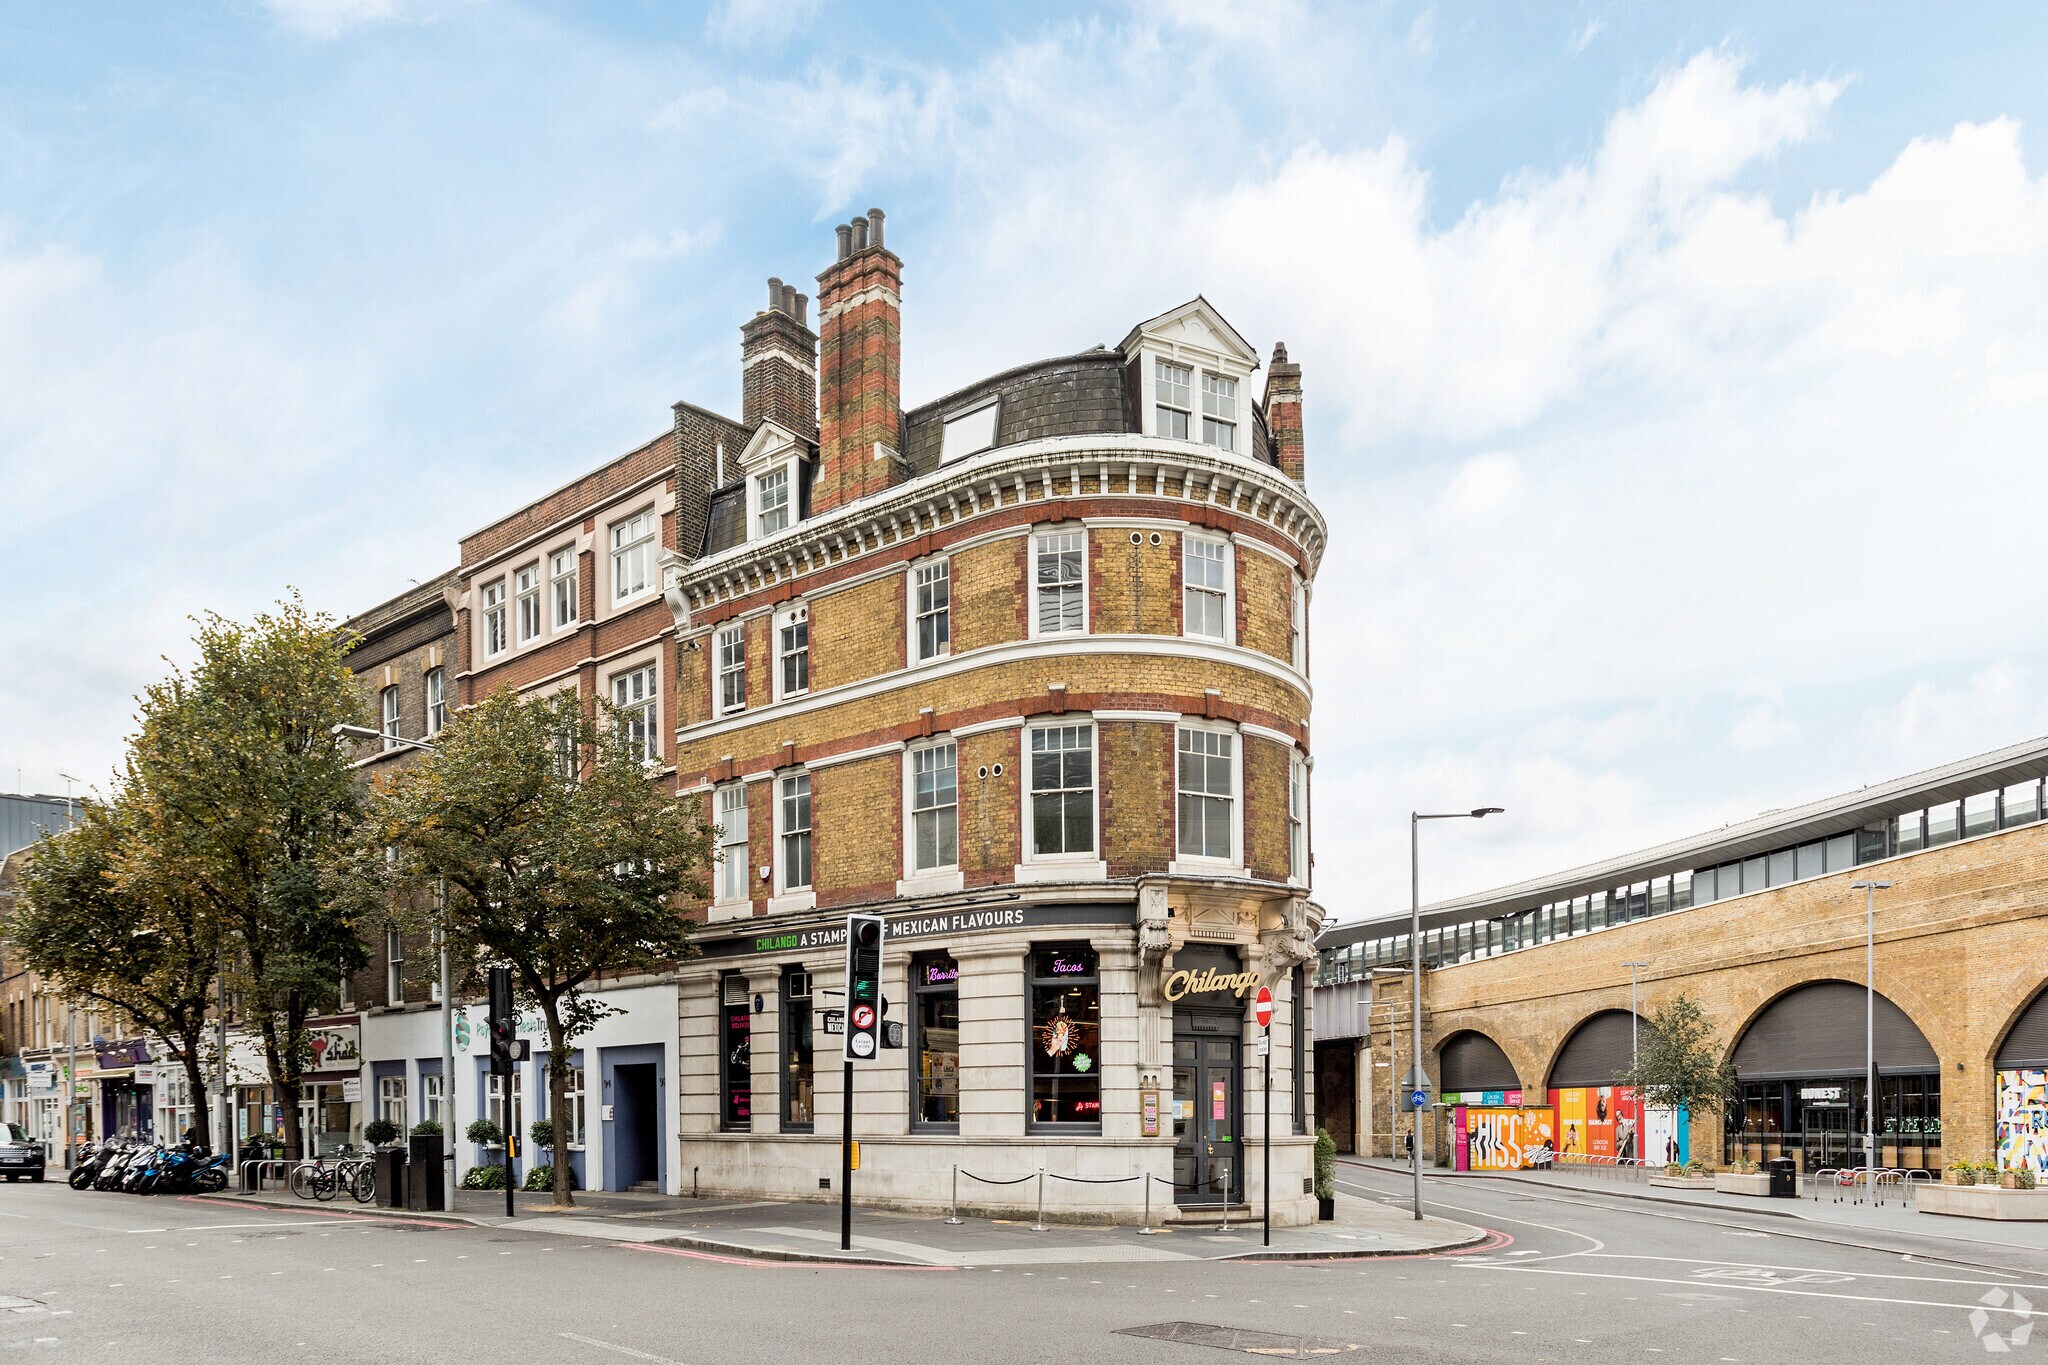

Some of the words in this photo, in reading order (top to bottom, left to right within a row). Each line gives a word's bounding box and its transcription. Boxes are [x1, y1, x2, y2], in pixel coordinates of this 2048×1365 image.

[756, 935, 798, 951] CHILANGO
[800, 935, 808, 947] A
[810, 931, 847, 945] STAMP
[892, 916, 948, 937] MEXICAN
[952, 909, 1024, 930] FLAVOURS
[1053, 959, 1083, 973] Tacos
[1164, 967, 1261, 1002] Chilango
[827, 1022, 844, 1033] MEXICA
[1475, 1113, 1523, 1168] HISS
